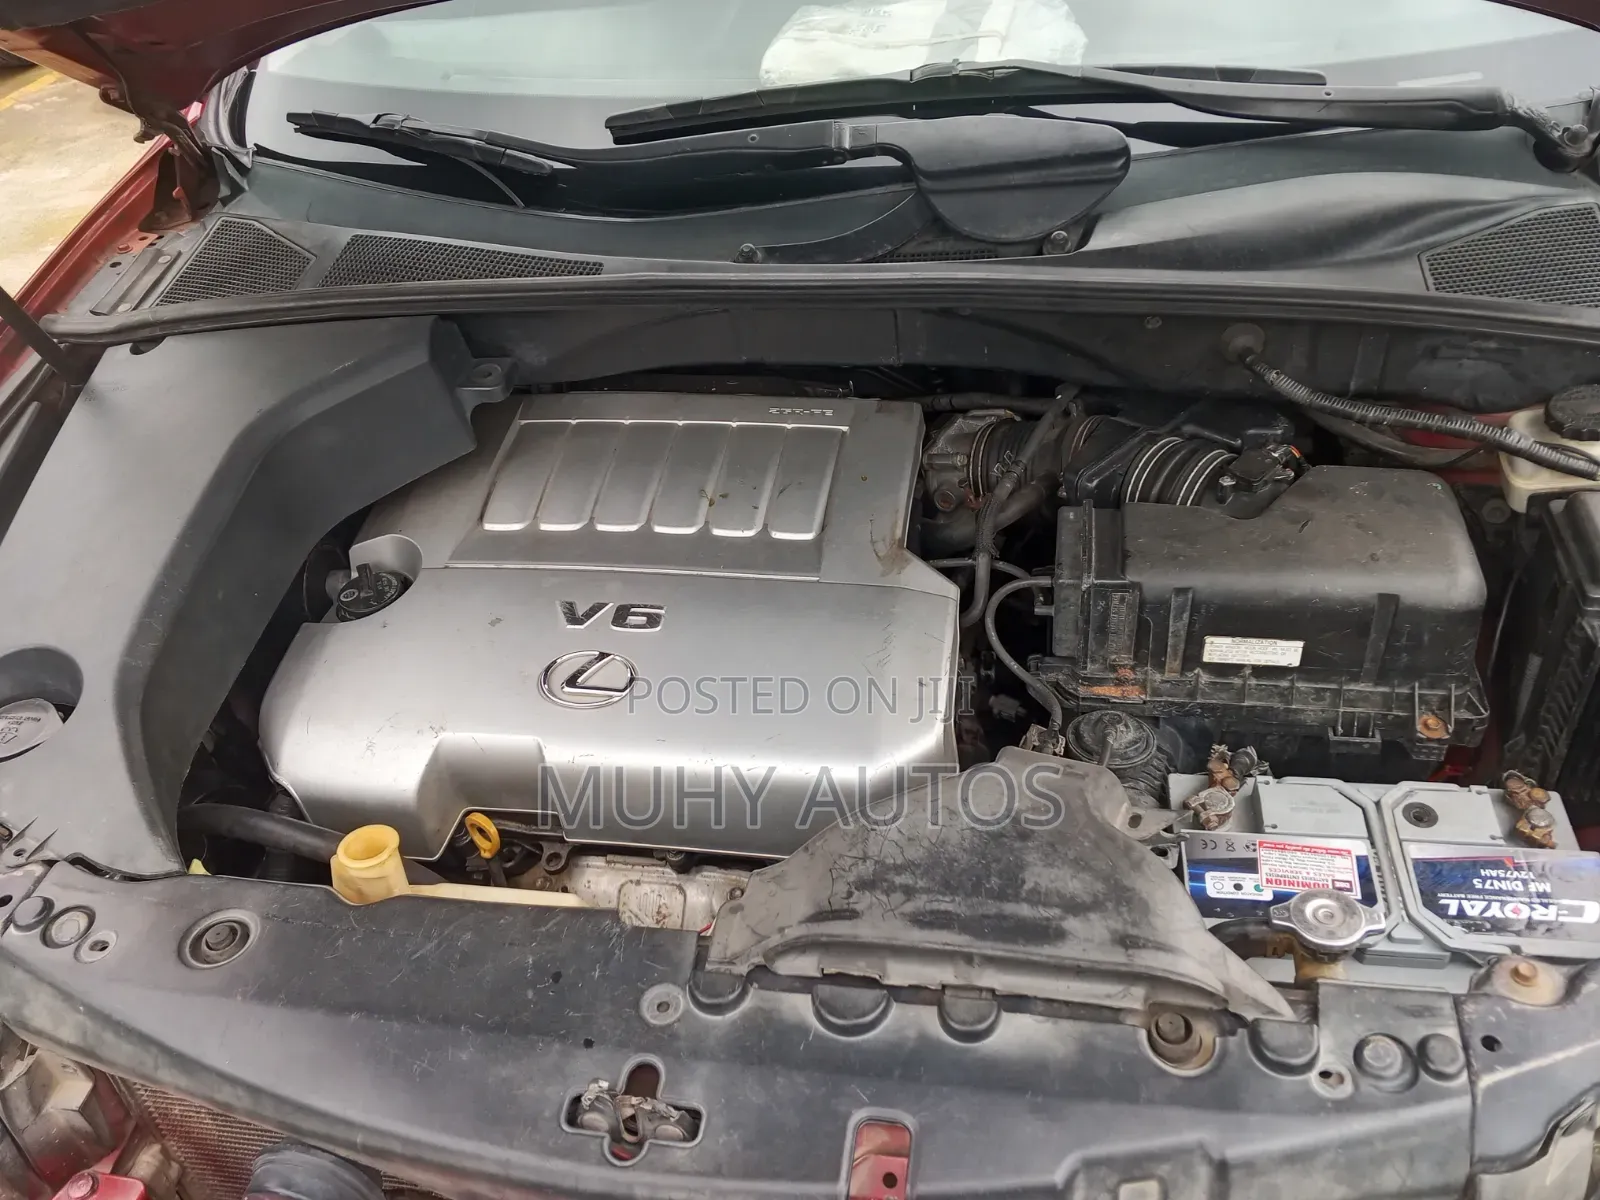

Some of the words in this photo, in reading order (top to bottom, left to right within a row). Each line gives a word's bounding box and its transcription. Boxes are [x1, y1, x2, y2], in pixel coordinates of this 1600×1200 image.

[556, 599, 667, 632] V6
[1265, 872, 1300, 880] ENTERPRISES
[1480, 868, 1536, 879] 12V75AH
[1265, 877, 1330, 889] DOMINION
[1472, 878, 1525, 892] DIN75
[1527, 882, 1552, 893] MF
